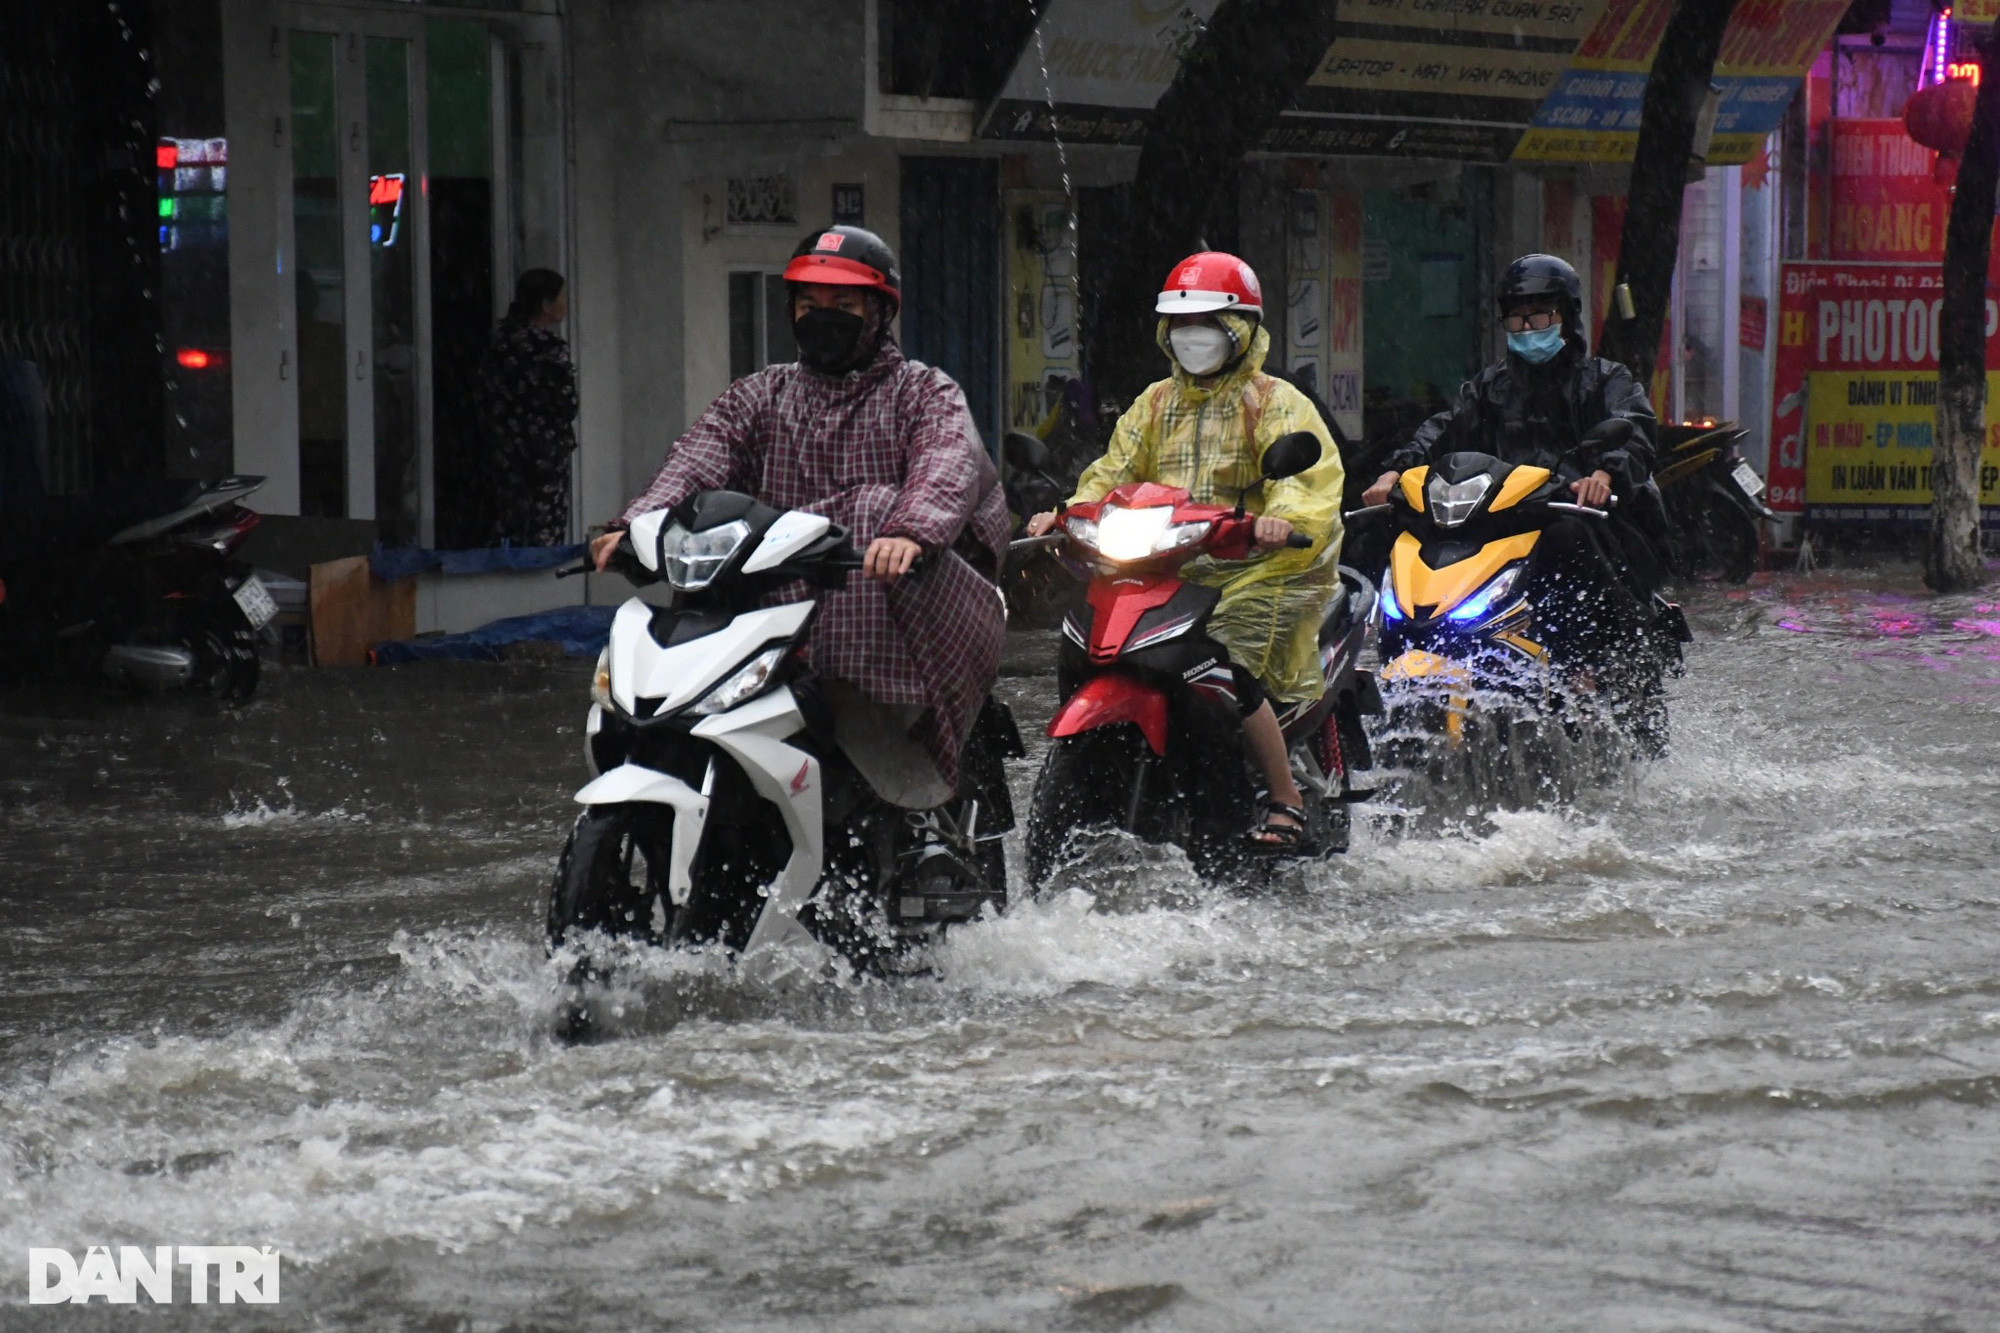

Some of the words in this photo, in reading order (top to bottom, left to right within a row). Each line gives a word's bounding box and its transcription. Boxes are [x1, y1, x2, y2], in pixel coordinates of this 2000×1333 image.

[1325, 56, 1394, 75] LAPTOP
[1547, 106, 1594, 125] SCAN
[1832, 466, 1847, 490] IN
[1182, 657, 1217, 680] HONDA
